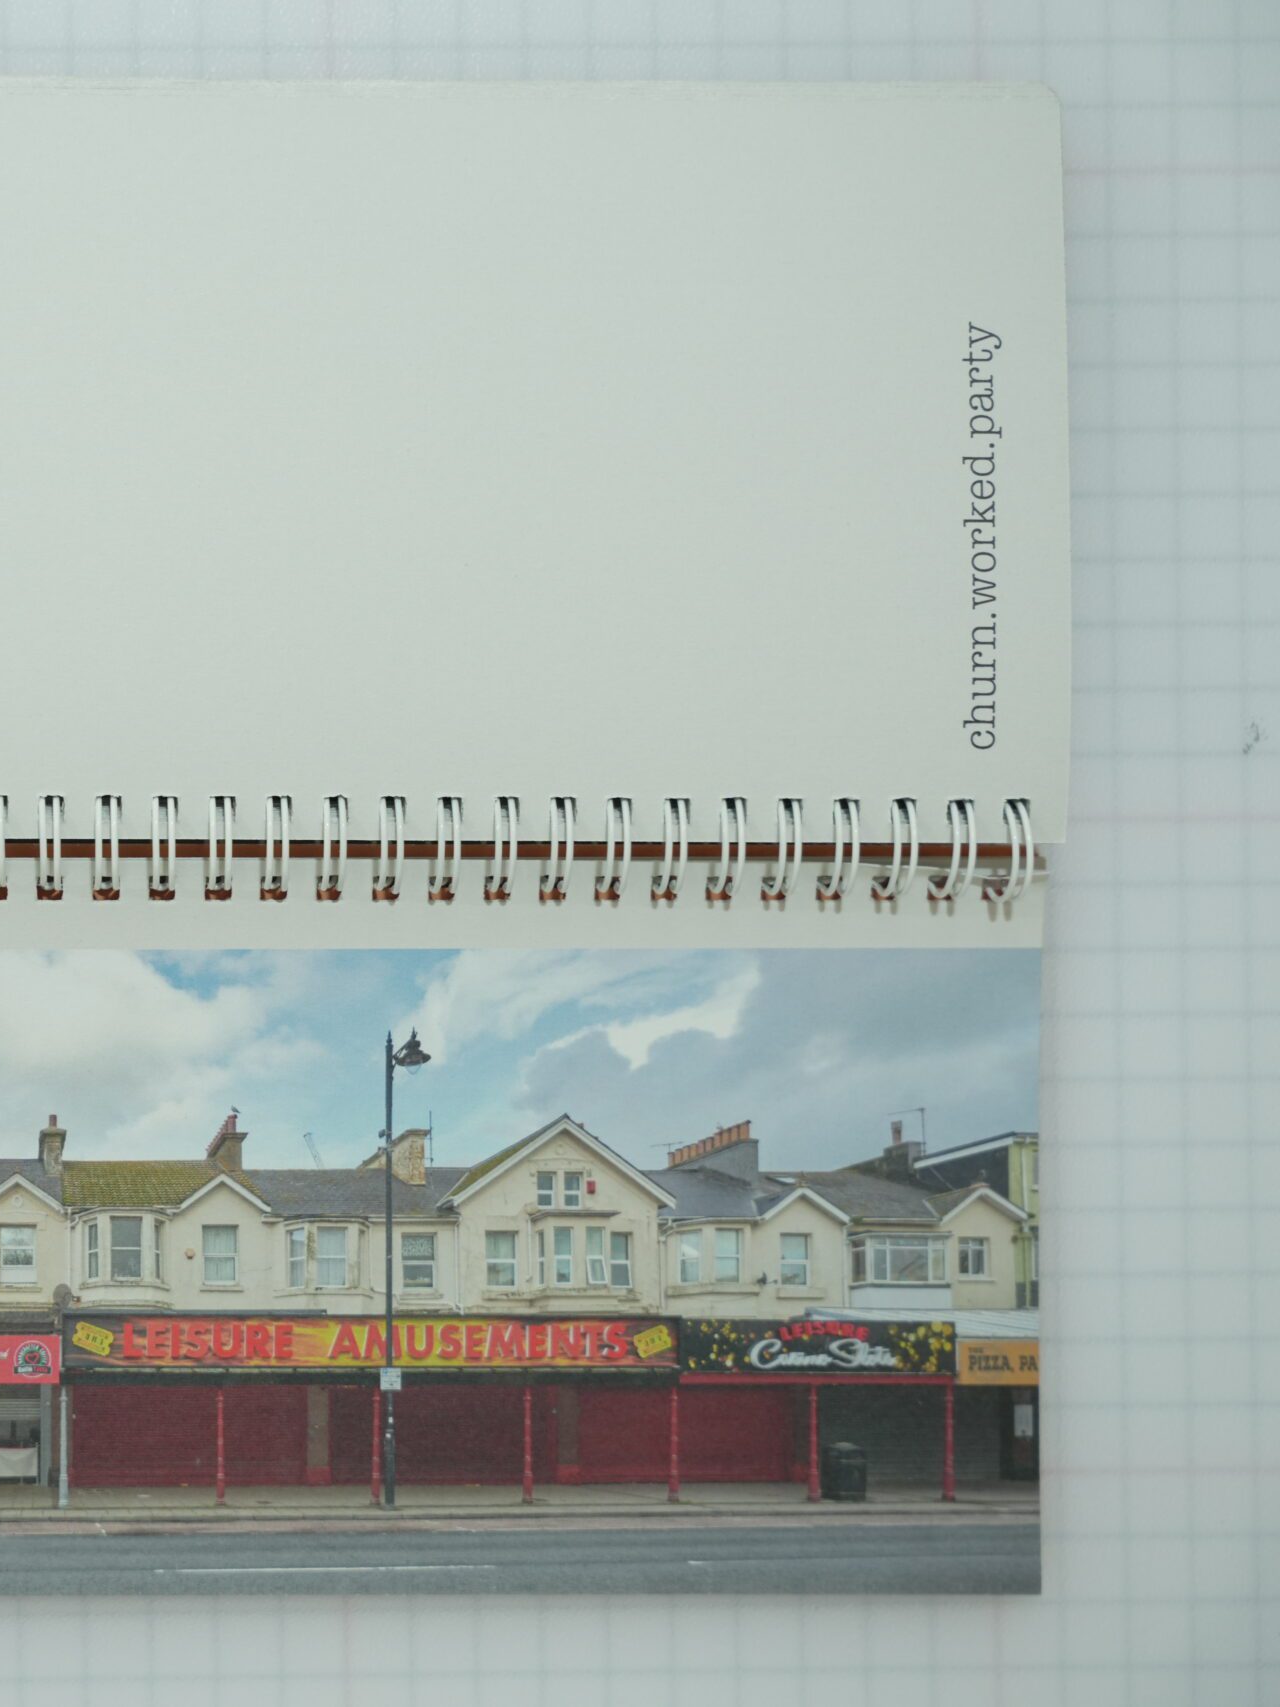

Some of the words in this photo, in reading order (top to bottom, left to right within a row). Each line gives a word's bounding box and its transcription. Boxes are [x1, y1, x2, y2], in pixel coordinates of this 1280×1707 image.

[962, 321, 1002, 749] churn.worked.party
[122, 1321, 294, 1359] LEISURE
[328, 1322, 628, 1360] AMUSEMENTS
[778, 1321, 869, 1341] LEISURE
[968, 1354, 1015, 1373] PIZZA,
